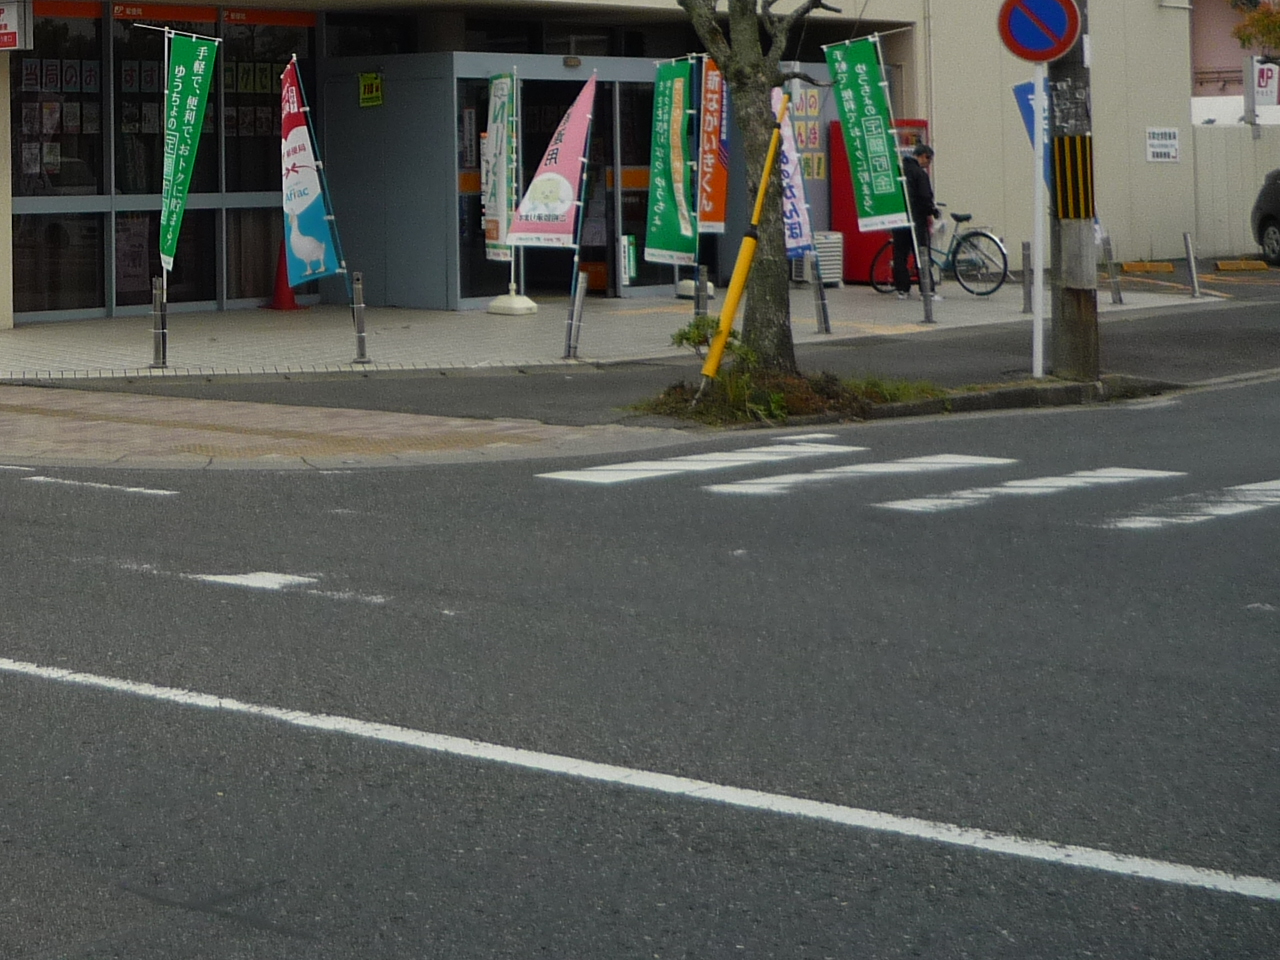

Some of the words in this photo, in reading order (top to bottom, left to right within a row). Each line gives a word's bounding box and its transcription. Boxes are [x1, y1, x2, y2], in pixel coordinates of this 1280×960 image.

[1257, 68, 1274, 88] JP
[701, 70, 720, 213] 新ながいきくん
[285, 187, 310, 203] Aflac
